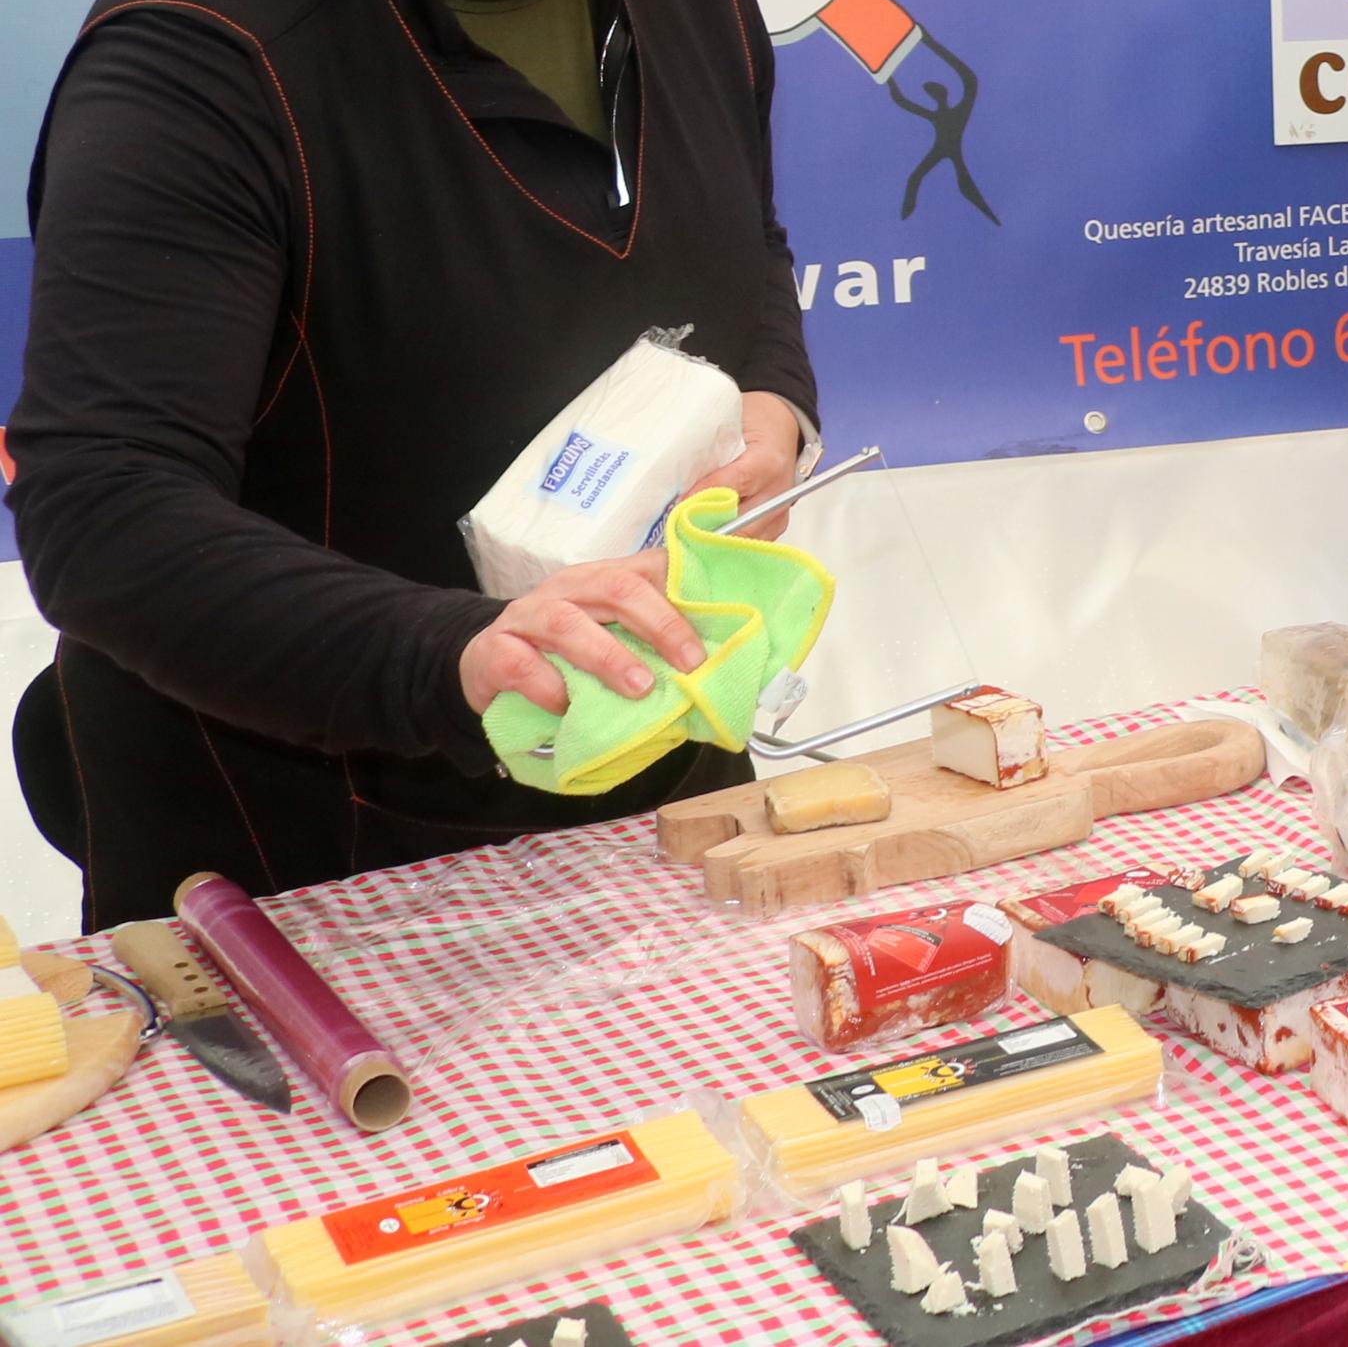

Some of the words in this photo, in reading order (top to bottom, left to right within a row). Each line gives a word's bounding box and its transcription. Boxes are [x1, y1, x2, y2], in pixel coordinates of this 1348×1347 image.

[1083, 214, 1186, 244] Quesería
[1191, 206, 1293, 235] artesanal
[1233, 237, 1321, 263] Travesía
[1184, 274, 1250, 299] 24839
[1257, 268, 1329, 294] Robles
[1058, 319, 1316, 388] Teléfono
[570, 451, 612, 498] Servilletas
[580, 450, 630, 510] Guardanapos
